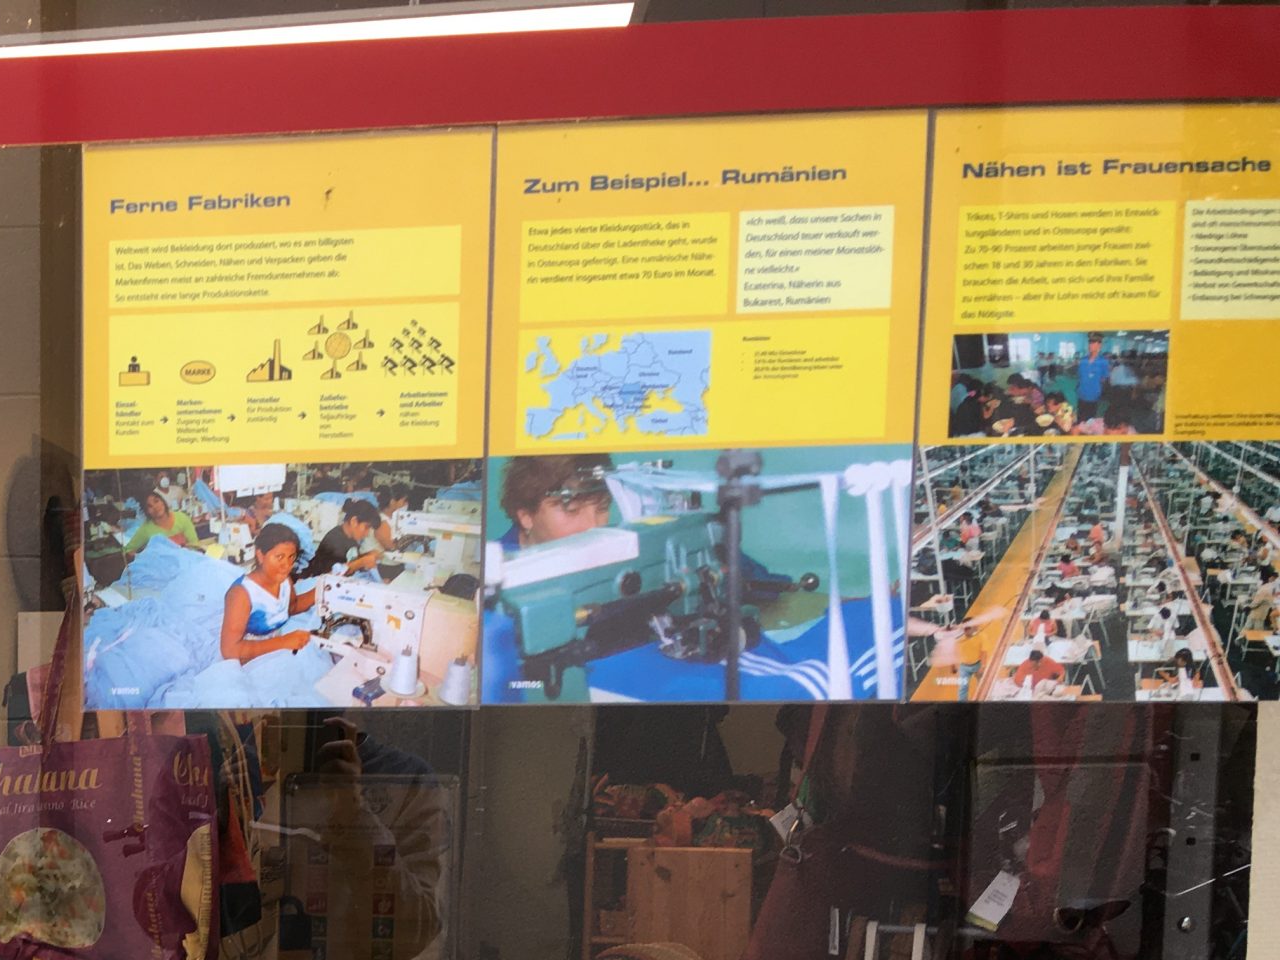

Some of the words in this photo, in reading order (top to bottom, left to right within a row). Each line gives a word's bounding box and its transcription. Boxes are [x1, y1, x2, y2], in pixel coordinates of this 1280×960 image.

[962, 161, 1045, 178] Nähen
[1057, 161, 1091, 175] ist
[1103, 157, 1271, 174] Frauensache
[523, 178, 579, 194] Zum
[590, 173, 709, 192] Beispiel...
[721, 167, 847, 185] Rumänien
[110, 199, 178, 214] Ferne
[188, 194, 291, 211] Fabriken
[152, 245, 168, 253] wird
[216, 242, 232, 251] dort
